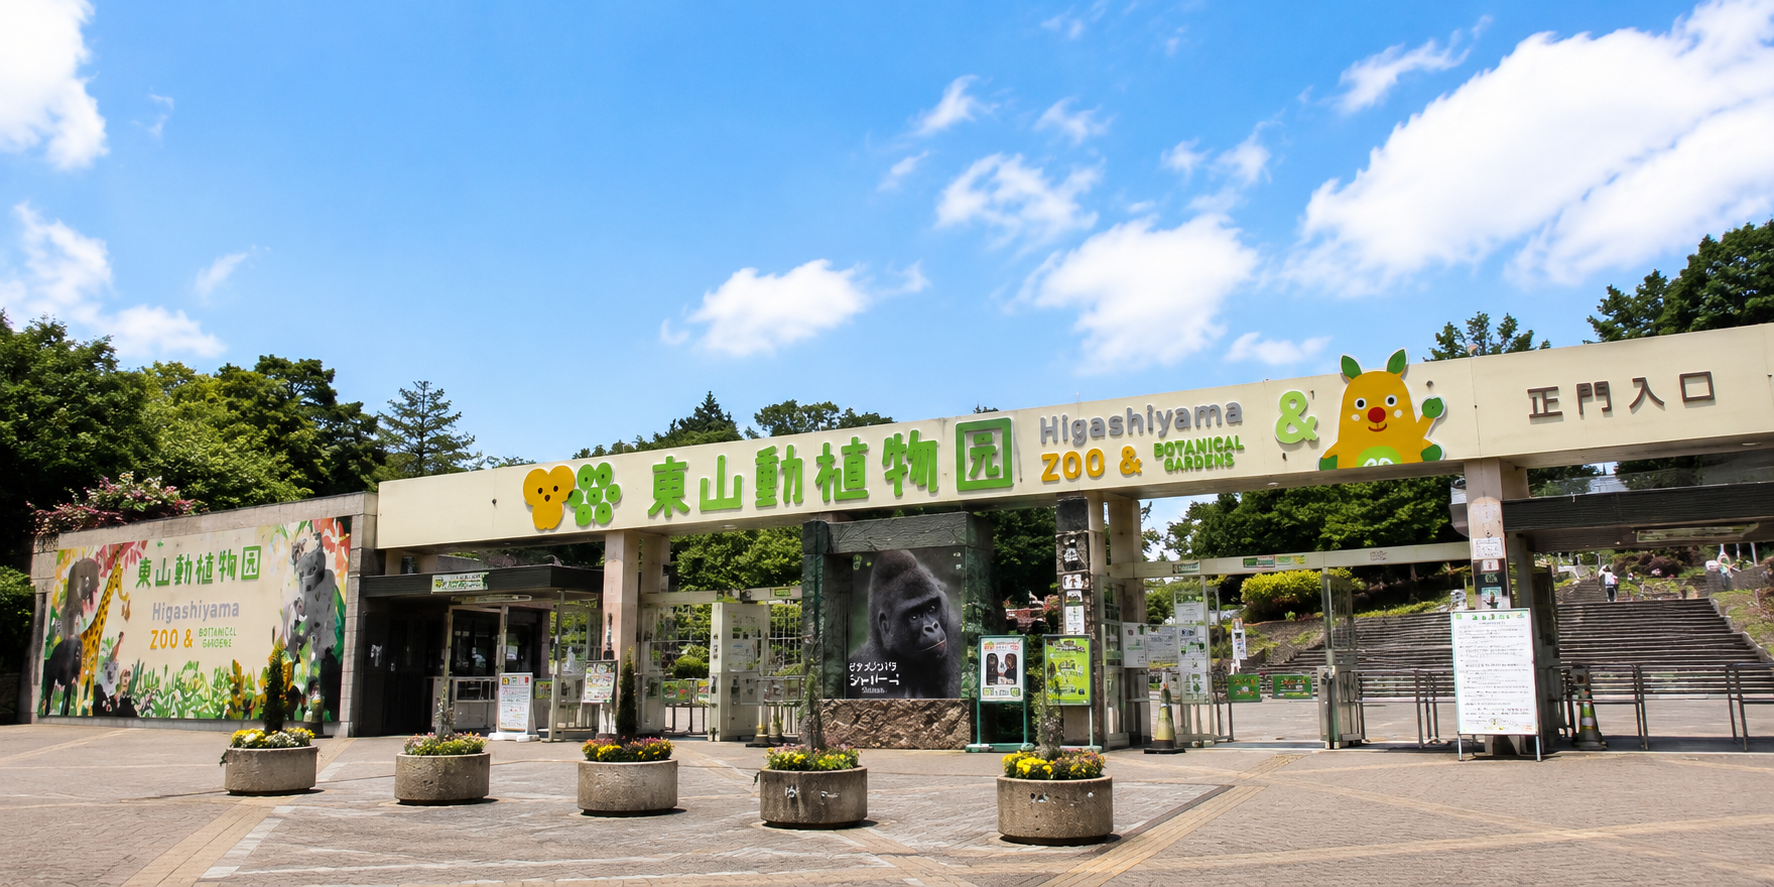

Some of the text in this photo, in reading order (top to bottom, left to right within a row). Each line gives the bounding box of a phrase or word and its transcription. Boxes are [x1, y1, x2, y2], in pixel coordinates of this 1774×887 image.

[1527, 371, 1715, 419] 正門入口
[1040, 401, 1243, 447] Higashiyama
[1275, 390, 1317, 444] &
[1154, 435, 1245, 458] BOTANICAL
[1041, 446, 1142, 482] ZOO &
[1164, 452, 1235, 472] GARDENS
[152, 600, 239, 624] Higashiyama
[150, 628, 193, 650] ZOO &
